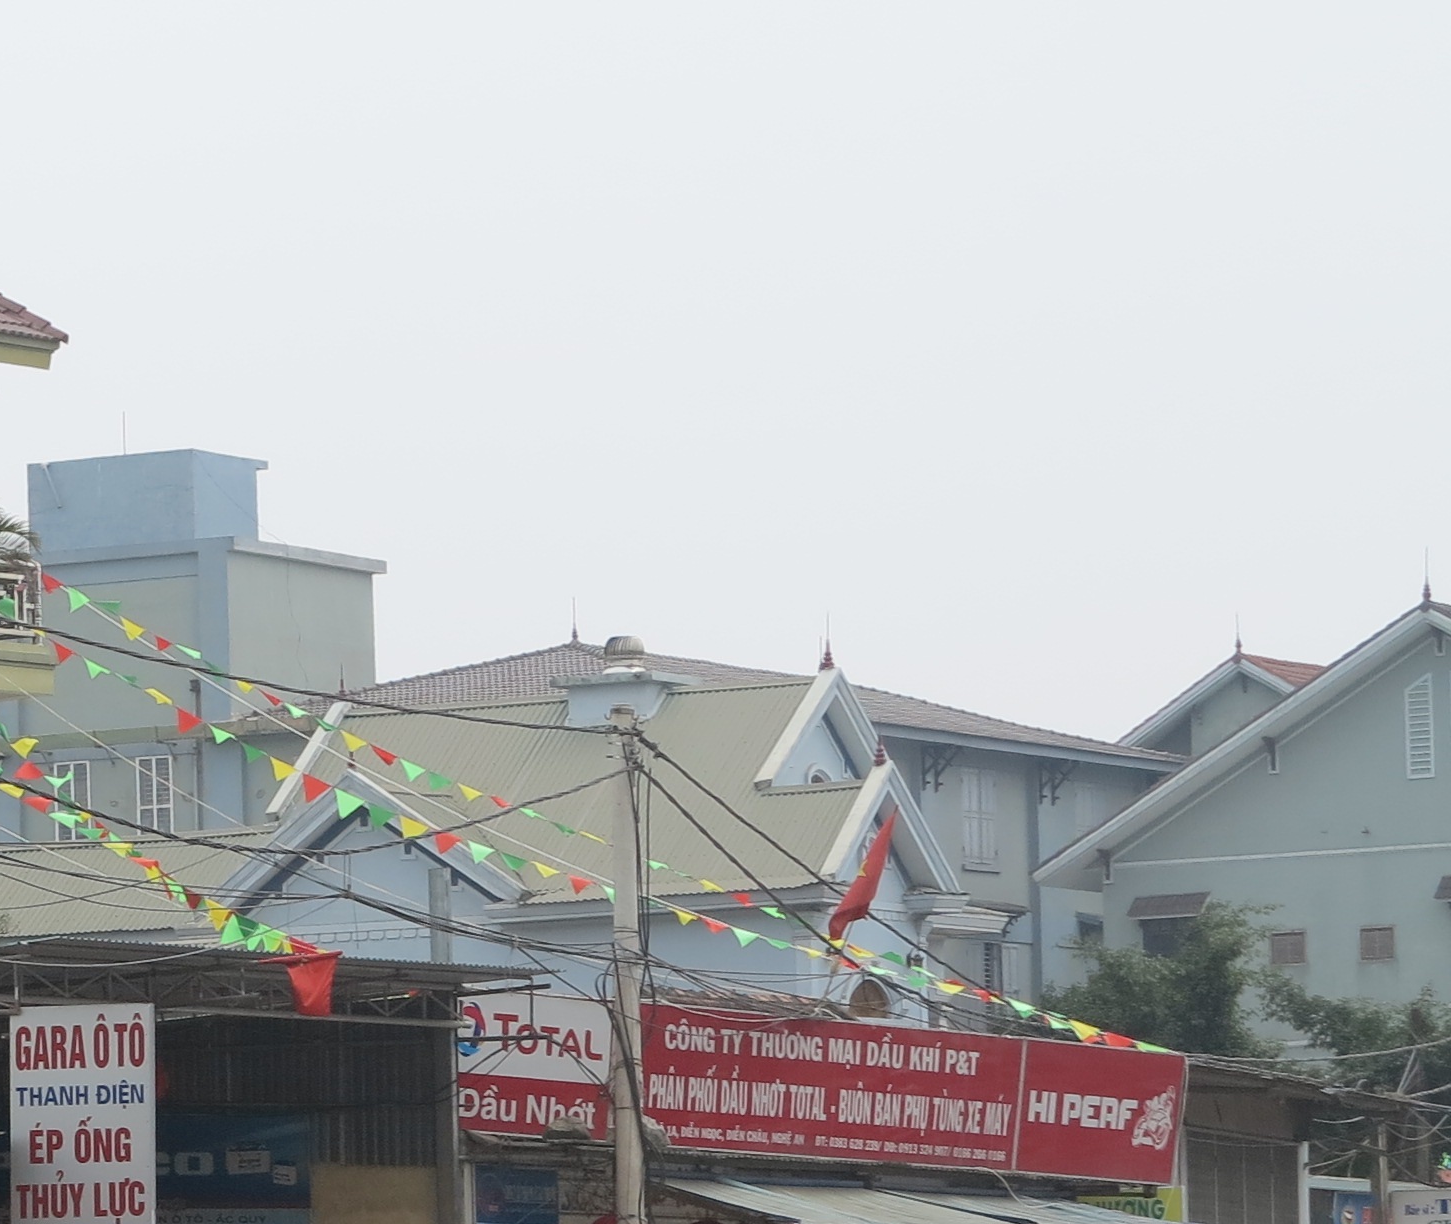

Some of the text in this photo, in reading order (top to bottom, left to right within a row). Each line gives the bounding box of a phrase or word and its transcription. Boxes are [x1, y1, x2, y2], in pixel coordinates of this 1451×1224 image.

[15, 1024, 87, 1071] GARA
[493, 1013, 603, 1061] TOTAL
[664, 1018, 980, 1076] CÔNG TY THƯƠNG MẠI DẦU KHÍ P&T
[15, 1079, 145, 1110] THANH ĐIỆN
[648, 1065, 686, 1111] PHÂN
[687, 1064, 718, 1114] PHỐI
[789, 1084, 827, 1121] TOTAL
[838, 1081, 872, 1125] BUÔN
[874, 1083, 902, 1127] BÁN
[903, 1094, 930, 1137] PHỤ
[932, 1088, 965, 1133] TÙNG
[965, 1100, 983, 1134] XE
[983, 1094, 1012, 1137] MÁY
[1027, 1088, 1057, 1123] HI
[28, 1122, 64, 1165] ÉP
[73, 1116, 132, 1164] ỐNG
[15, 1170, 146, 1224] THỦY LỰC
